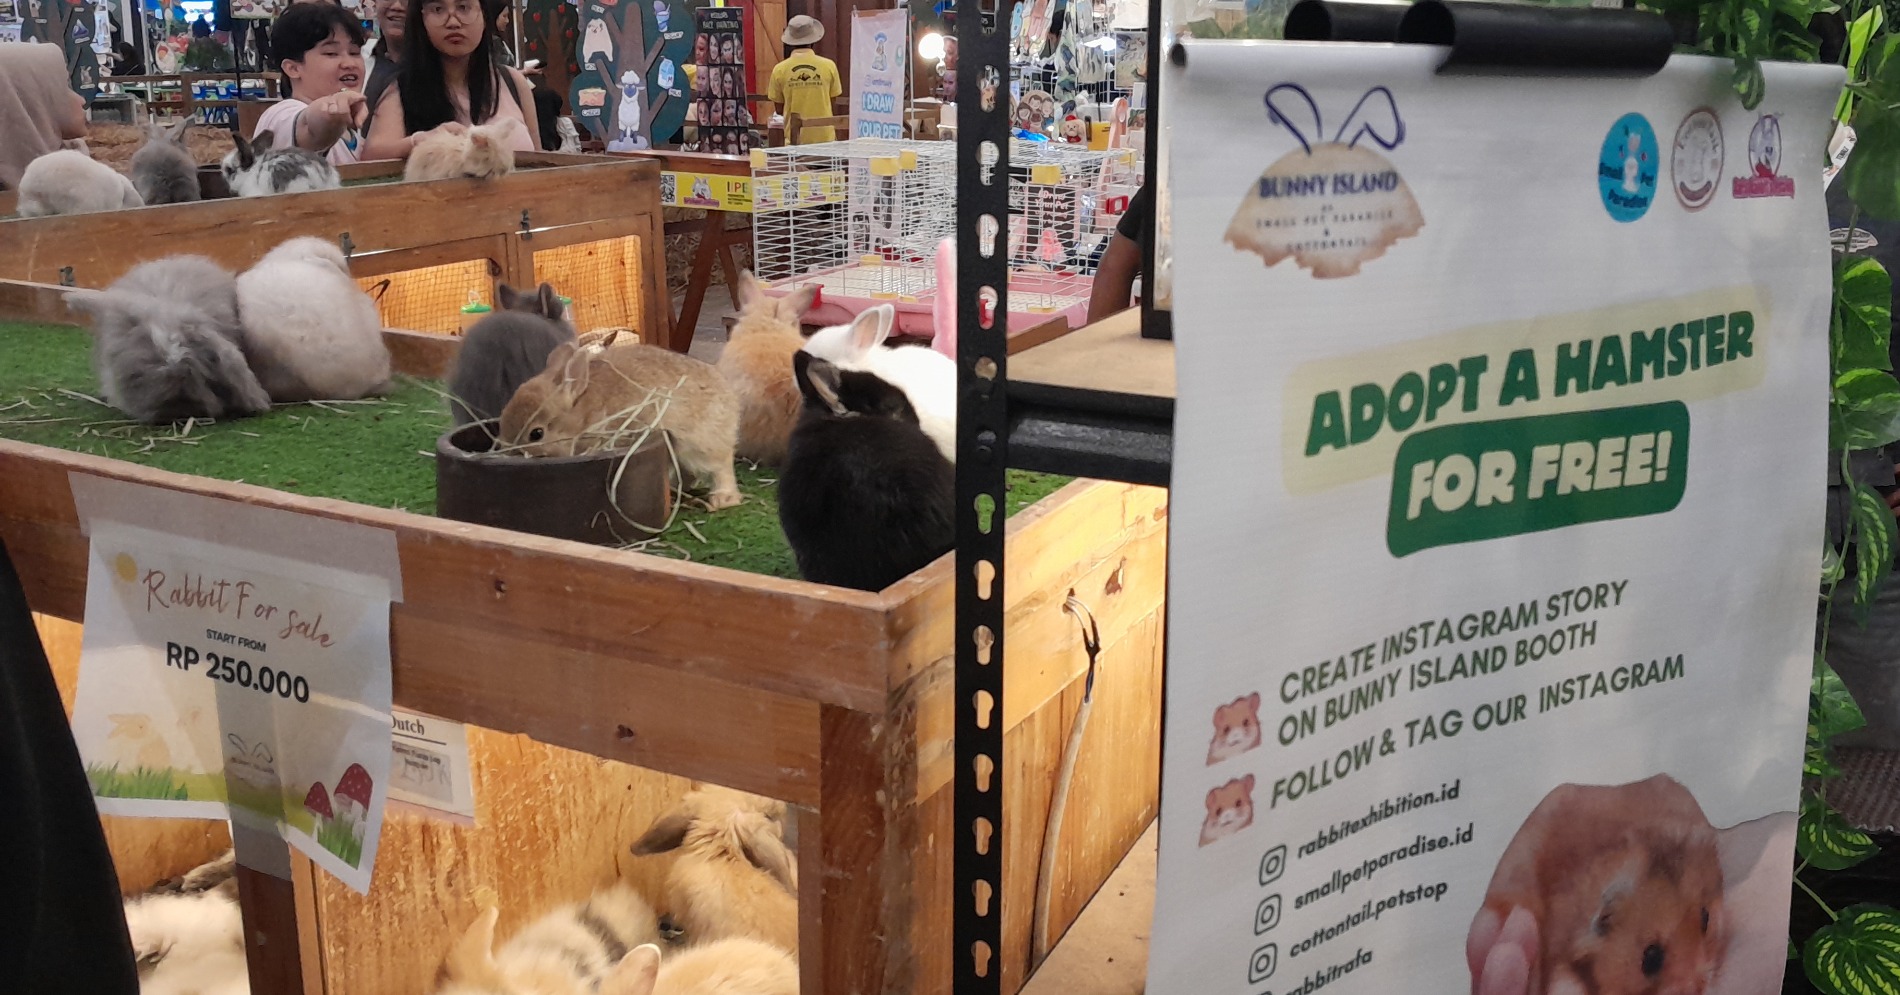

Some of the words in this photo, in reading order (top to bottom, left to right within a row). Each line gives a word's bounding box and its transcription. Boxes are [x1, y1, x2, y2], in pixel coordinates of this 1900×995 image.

[857, 119, 881, 139] YOUR
[882, 122, 901, 139] PET
[867, 92, 895, 114] DRAW
[1259, 174, 1329, 198] BUNNY
[1332, 171, 1399, 194] ISLAND
[1304, 354, 1488, 456] ADOPT
[1499, 349, 1540, 406] A
[1554, 311, 1755, 397] HAMSTER
[1406, 449, 1517, 520] FOR
[1527, 430, 1673, 500] FREE!
[143, 568, 231, 614] Rabbit
[235, 581, 278, 620] For
[166, 641, 200, 671] RP
[205, 651, 310, 704] 250.000
[206, 628, 236, 646] START
[237, 636, 267, 653] FROM
[1279, 643, 1376, 704] CREATE
[1380, 600, 1539, 665] INSTAGRAM
[1545, 579, 1629, 622] STORY
[1278, 704, 1317, 746] ON
[1323, 668, 1402, 728] BUNNY
[1409, 645, 1508, 692] ISLAND
[1514, 620, 1598, 668] BOOTH
[1270, 735, 1375, 810] FOLLOW
[1378, 727, 1396, 757] &
[1404, 708, 1464, 749] TAG
[1472, 694, 1527, 732] OUR
[1538, 653, 1685, 714] INSTAGRAM
[1297, 778, 1461, 859] rabbitexhibition.id
[1293, 822, 1475, 910] smallpetparadise.id
[1289, 881, 1449, 958] cottontail.petstop
